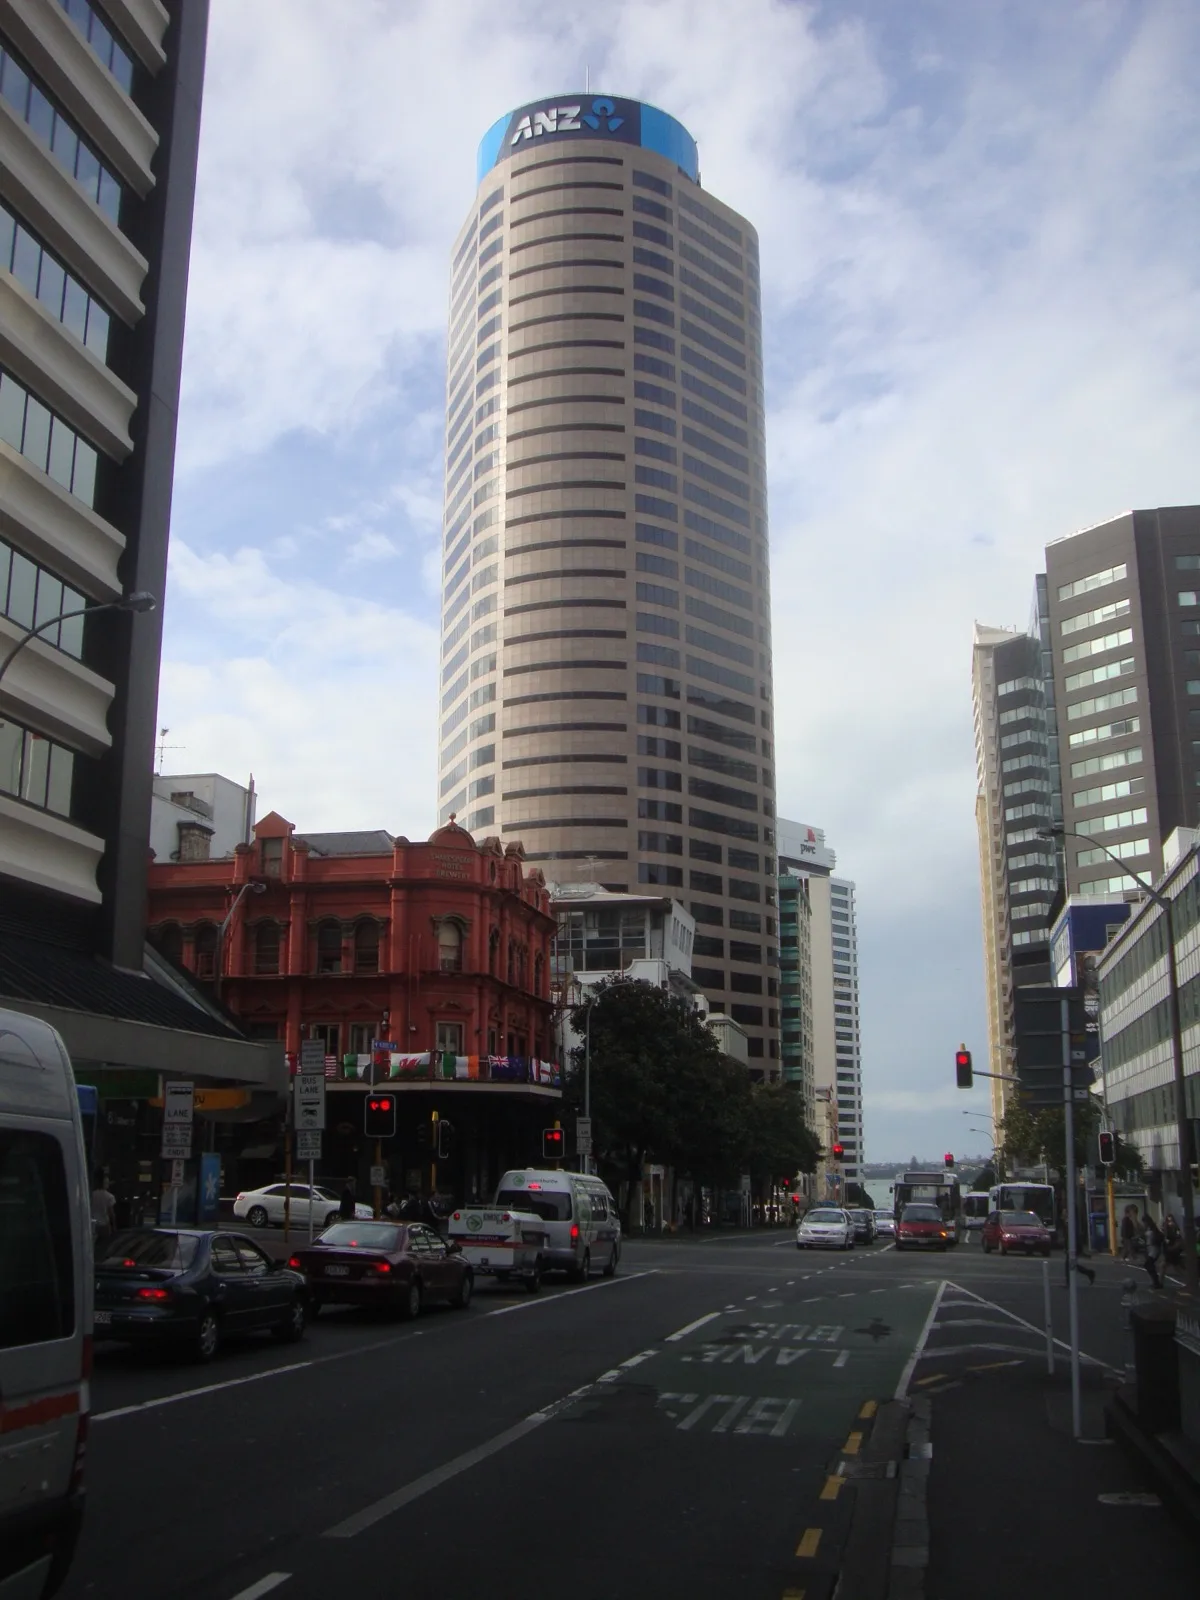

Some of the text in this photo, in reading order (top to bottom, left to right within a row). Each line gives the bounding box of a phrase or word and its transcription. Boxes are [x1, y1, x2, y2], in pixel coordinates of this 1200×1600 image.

[510, 105, 581, 146] ANZ
[800, 843, 816, 855] pwc
[302, 1077, 317, 1085] BUS
[299, 1086, 320, 1095] LANE
[167, 1109, 189, 1118] LANE
[680, 1344, 850, 1367] LANE
